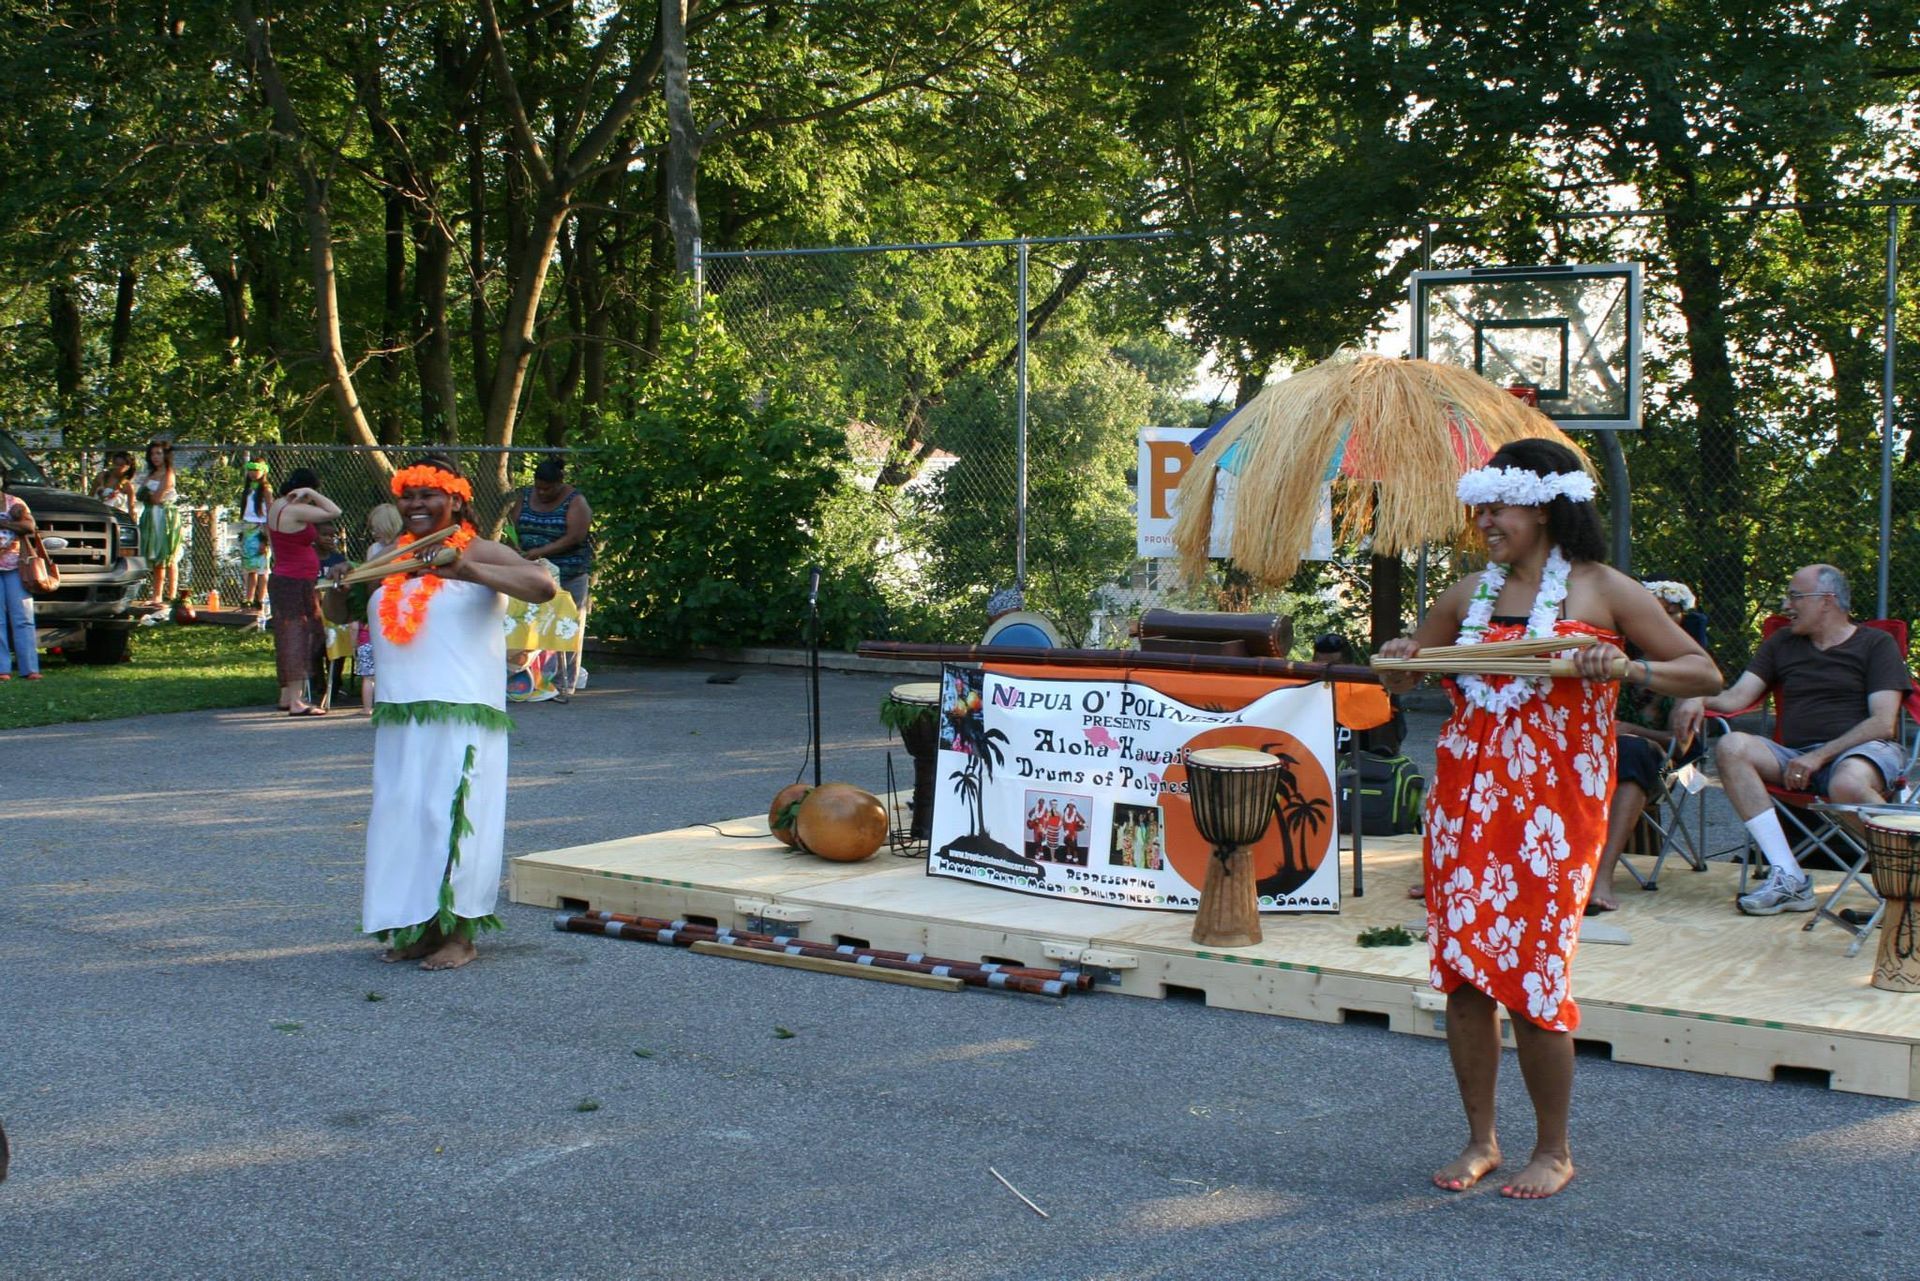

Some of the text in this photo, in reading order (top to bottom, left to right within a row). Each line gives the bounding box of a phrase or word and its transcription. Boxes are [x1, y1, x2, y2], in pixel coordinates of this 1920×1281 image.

[991, 683, 1244, 724] NAPUA O' POLYNESIA
[1083, 714, 1151, 732] PRESENTS
[1034, 729, 1109, 758] Aloha
[1016, 757, 1190, 797] Drums of Polynes
[939, 860, 1331, 907] HAWAII TAHITI MAORI PHILIPPINES MAR SAMOA
[1066, 868, 1156, 890] REPRESENTING
